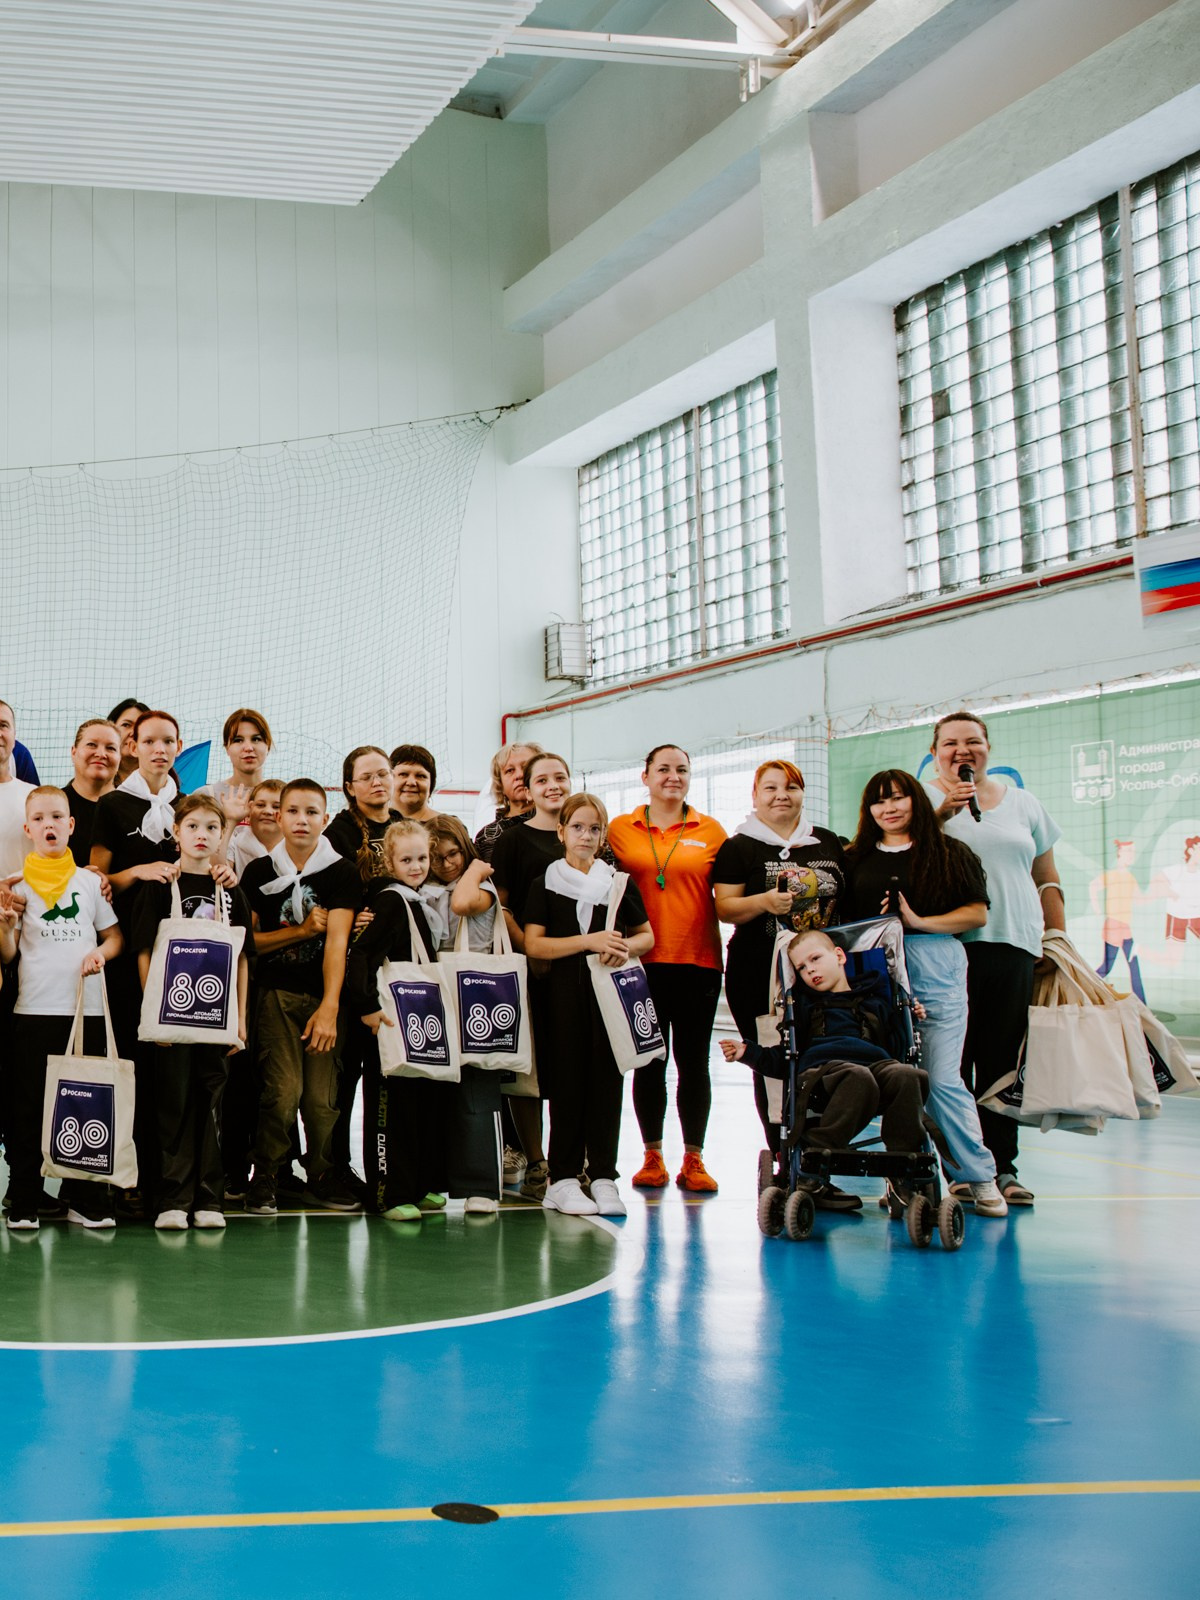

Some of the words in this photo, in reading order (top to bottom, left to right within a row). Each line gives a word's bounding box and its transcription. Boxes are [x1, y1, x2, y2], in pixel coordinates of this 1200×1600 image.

[1119, 761, 1165, 776] города
[1120, 772, 1200, 792] Усолье-Сиб
[41, 929, 81, 937] GUSSI
[168, 972, 224, 1012] 80
[407, 1012, 442, 1050] 80
[466, 1003, 516, 1041] 80
[67, 1089, 93, 1098] РОСАТОМ
[56, 1116, 110, 1157] 80
[377, 1133, 388, 1176] JOMOTO
